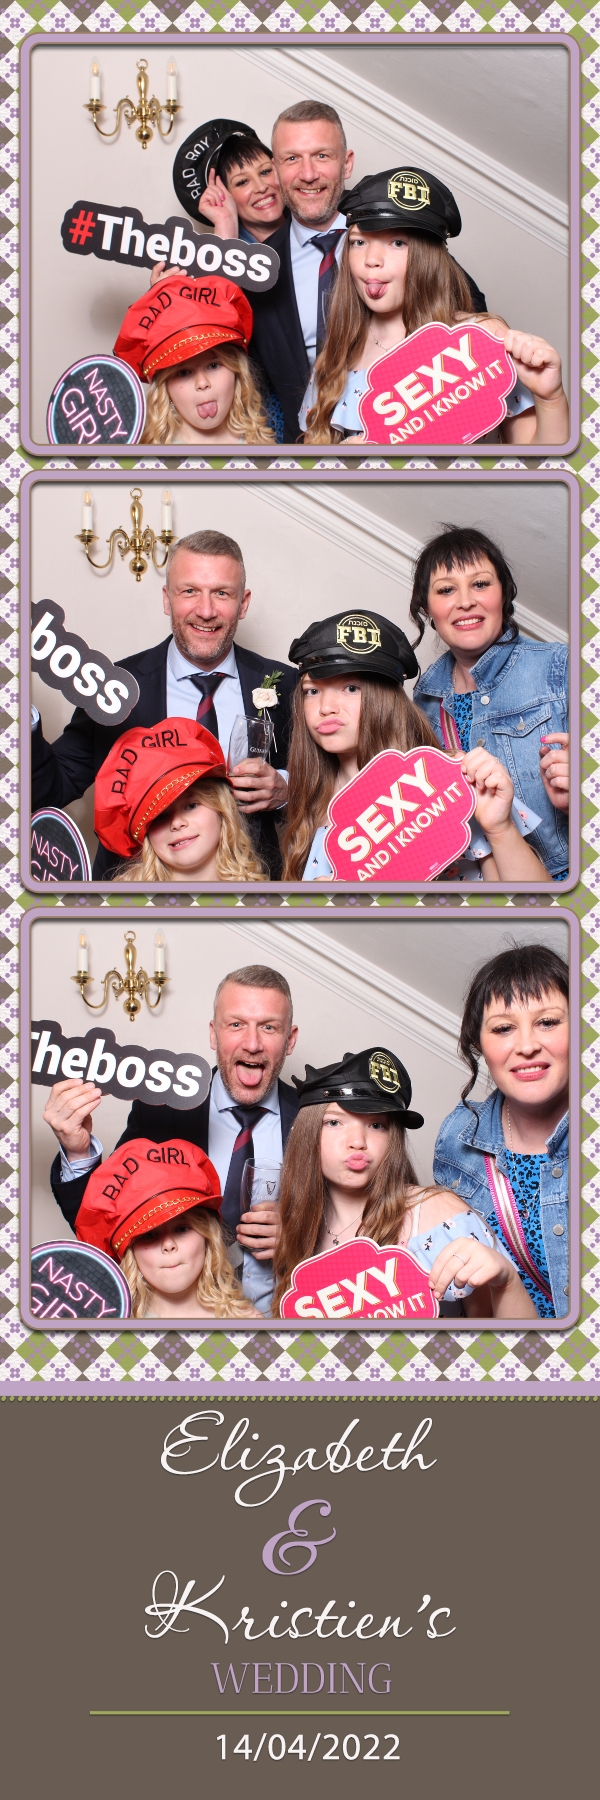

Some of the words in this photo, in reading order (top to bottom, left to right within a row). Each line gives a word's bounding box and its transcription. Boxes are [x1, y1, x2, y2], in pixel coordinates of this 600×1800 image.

[185, 136, 210, 161] BOY
[182, 168, 201, 200] BAD
[388, 179, 430, 205] FBI
[68, 209, 273, 282] #Theboss
[138, 291, 172, 331] BAD
[179, 286, 221, 307] GIRL
[83, 367, 128, 439] NASTY
[372, 333, 479, 427] SEXY
[388, 416, 426, 444] AND
[423, 409, 435, 422] I
[431, 372, 486, 417] KNOW
[485, 359, 504, 380] IT
[336, 624, 381, 647] FBI
[111, 748, 138, 795] BAD
[141, 728, 188, 748] GIRL
[337, 757, 437, 863] SEXY
[449, 781, 464, 804] IT
[390, 841, 400, 855] I
[394, 796, 447, 849] KNOW
[31, 830, 79, 881] NASTY
[356, 850, 391, 881] AND
[31, 1031, 203, 1098] heboss
[369, 1058, 401, 1088] FBI
[102, 1157, 139, 1201] BAD
[146, 1147, 191, 1168] GIRL
[38, 1256, 117, 1318] NASTY
[294, 1257, 402, 1318] SEXY
[406, 1292, 426, 1312] IT
